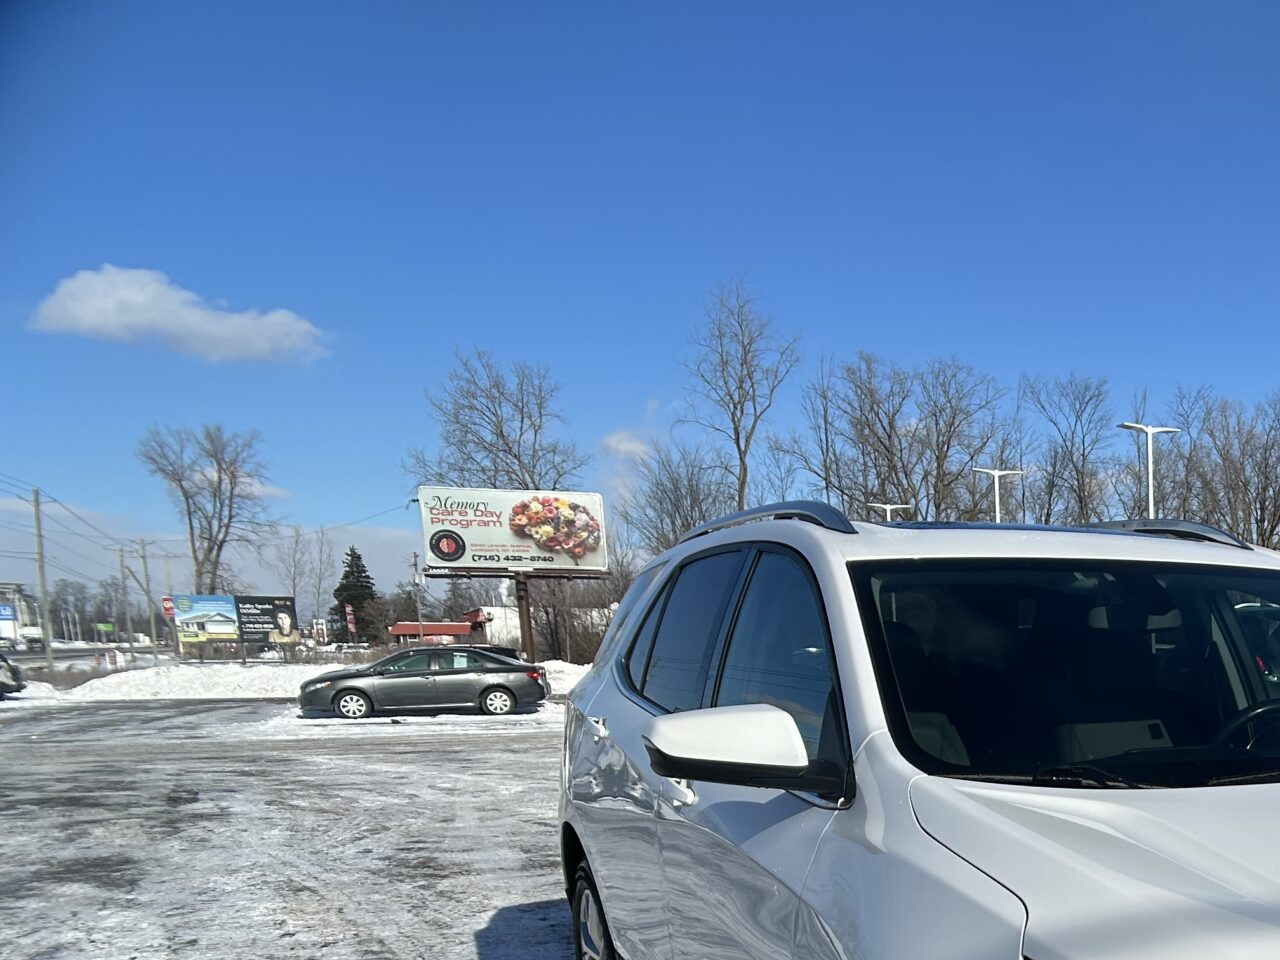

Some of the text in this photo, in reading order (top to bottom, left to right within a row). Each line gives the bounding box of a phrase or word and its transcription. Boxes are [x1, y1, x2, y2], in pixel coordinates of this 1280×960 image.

[424, 495, 488, 512] Memory
[429, 507, 503, 520] Care Day
[430, 517, 502, 528] Program
[471, 553, 500, 562] (716)
